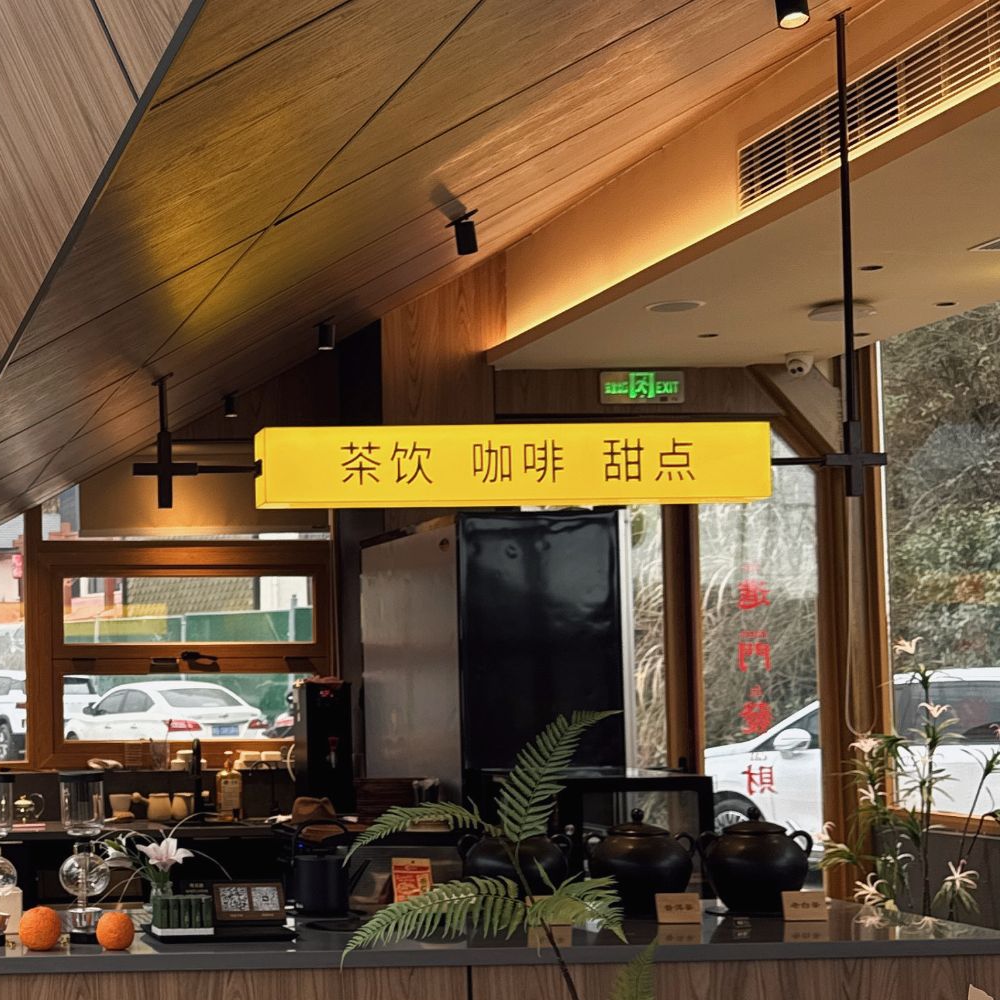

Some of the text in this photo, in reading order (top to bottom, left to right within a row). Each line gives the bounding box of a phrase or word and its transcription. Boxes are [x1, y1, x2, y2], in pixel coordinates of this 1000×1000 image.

[656, 380, 680, 395] EXIT
[340, 436, 696, 486] 茶饮 咖啡 甜点
